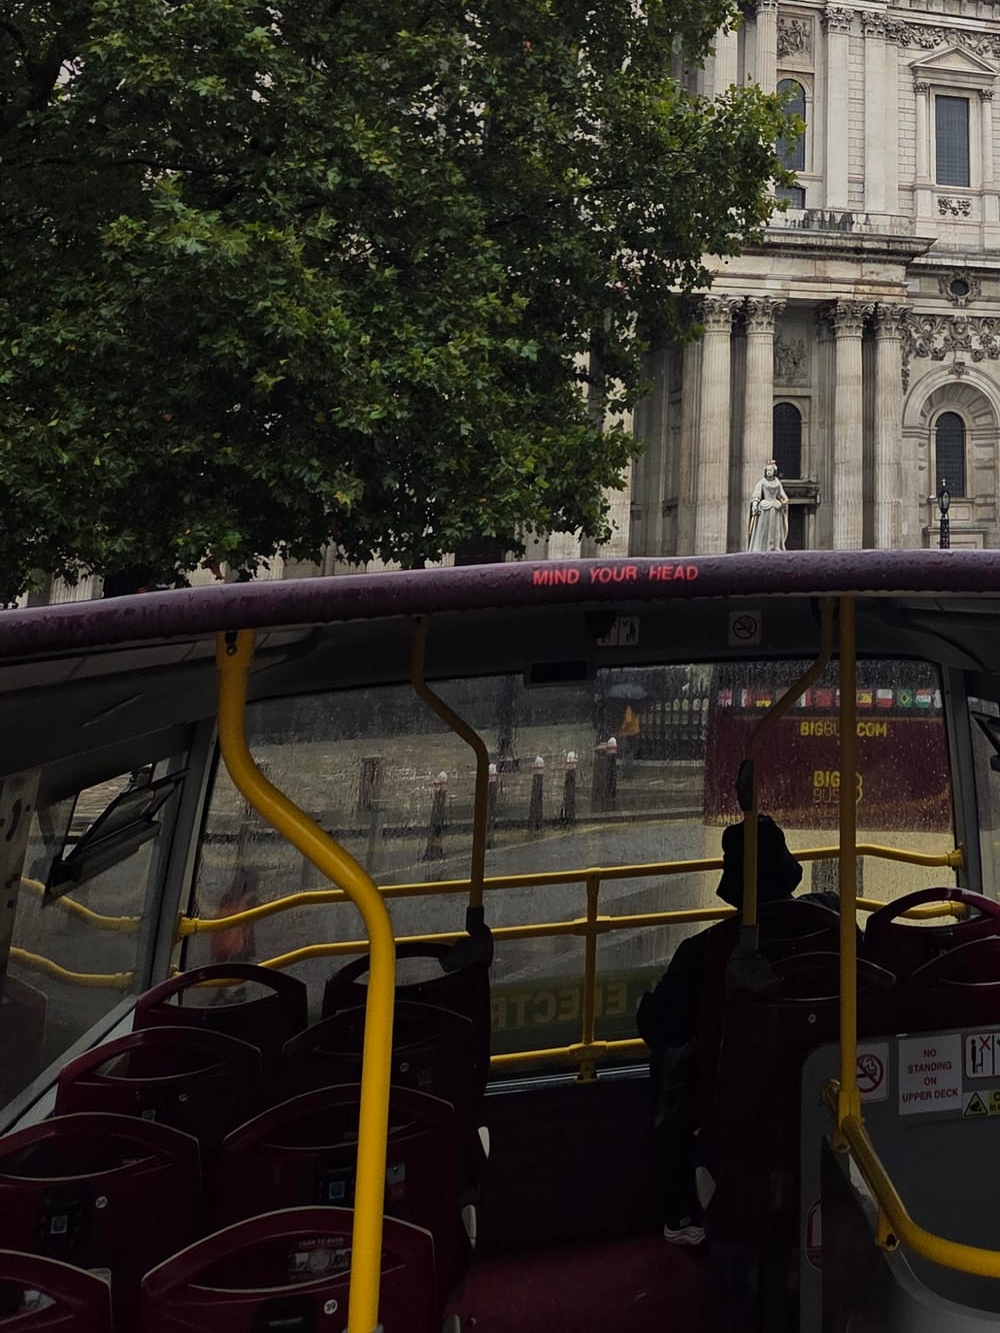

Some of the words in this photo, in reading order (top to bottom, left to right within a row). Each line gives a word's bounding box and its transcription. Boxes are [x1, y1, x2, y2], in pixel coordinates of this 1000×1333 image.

[532, 568, 580, 586] MIND
[589, 565, 638, 584] YOUR
[647, 565, 699, 581] HEAD
[813, 770, 841, 788] BIG
[923, 1049, 937, 1058] NO
[907, 1061, 952, 1074] STANDING
[923, 1076, 937, 1086] ON
[902, 1090, 932, 1103] UPPER
[934, 1088, 959, 1099] DECK
